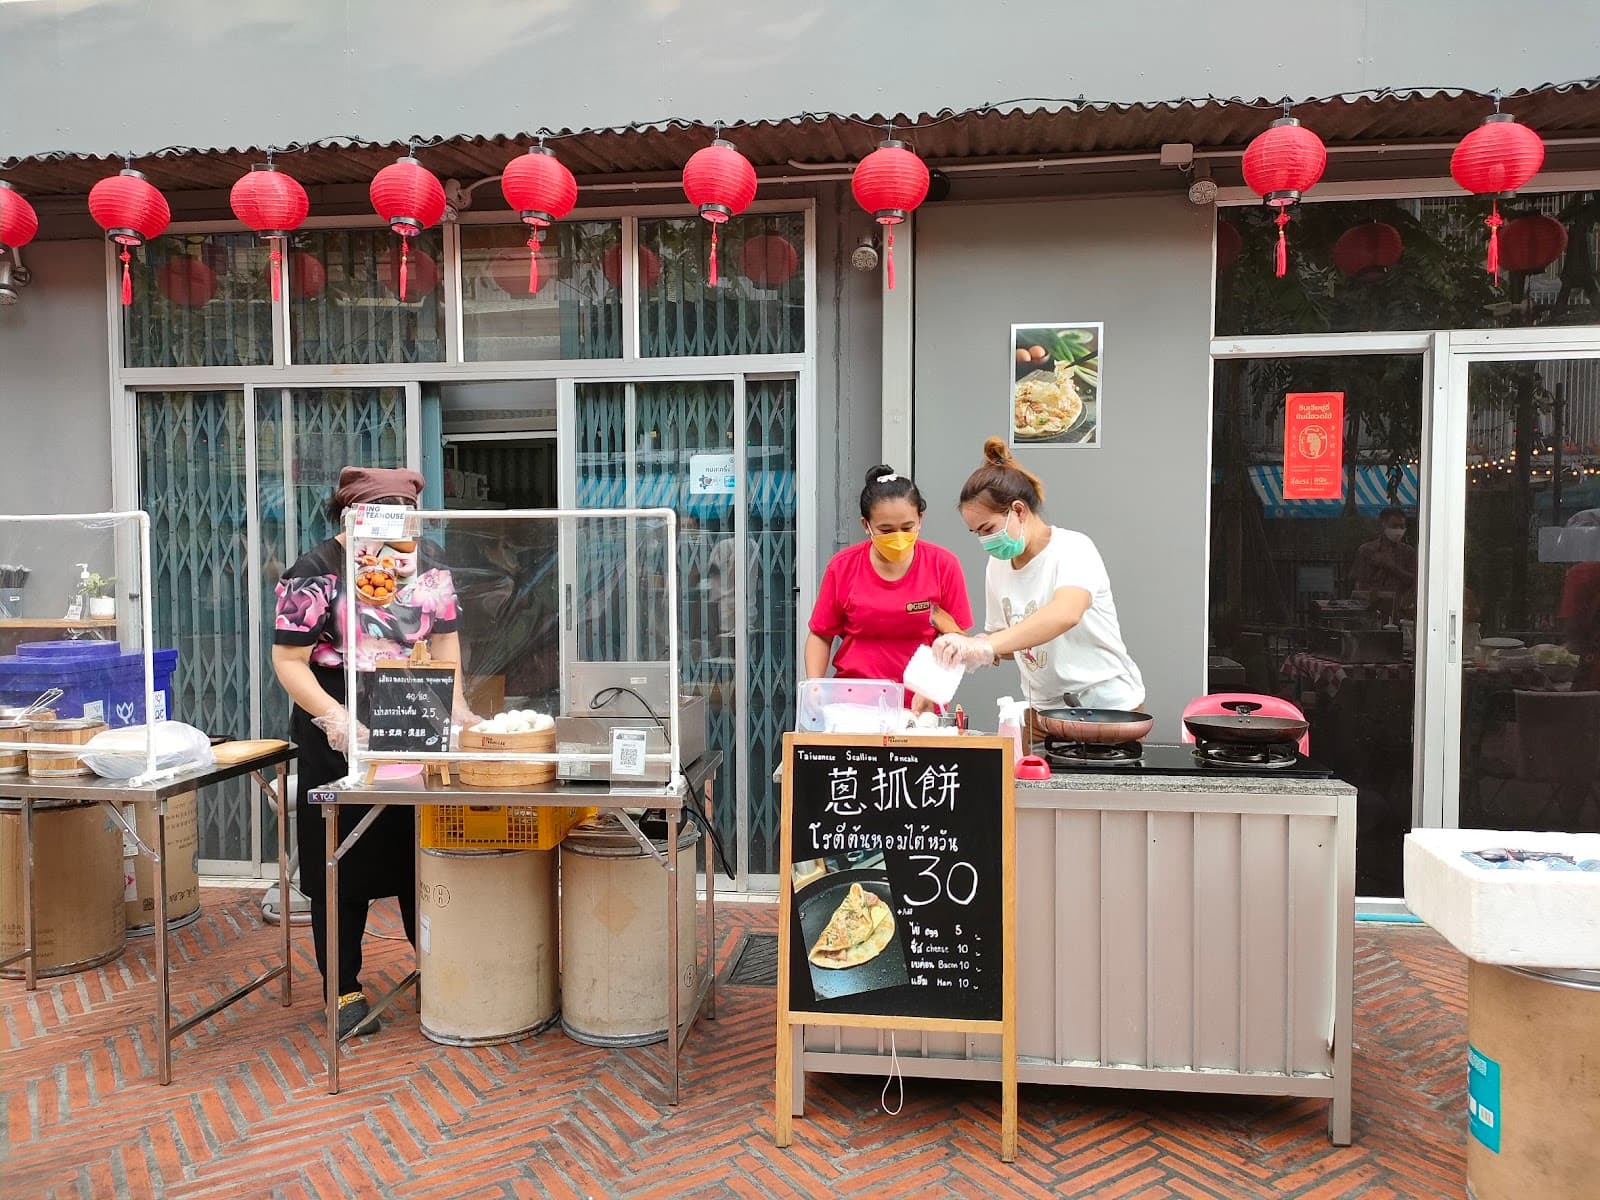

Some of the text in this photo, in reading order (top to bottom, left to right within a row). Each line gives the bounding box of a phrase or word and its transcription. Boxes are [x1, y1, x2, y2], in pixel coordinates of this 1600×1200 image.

[798, 750, 918, 762] Taiwanese Scallion Pancake
[903, 855, 978, 906] 30
[924, 928, 938, 938] egg
[955, 924, 962, 936] 5
[926, 944, 949, 953] cheese
[957, 944, 968, 953] 10
[938, 960, 958, 969] Bacon
[959, 960, 969, 970] 10
[959, 978, 969, 988] 10
